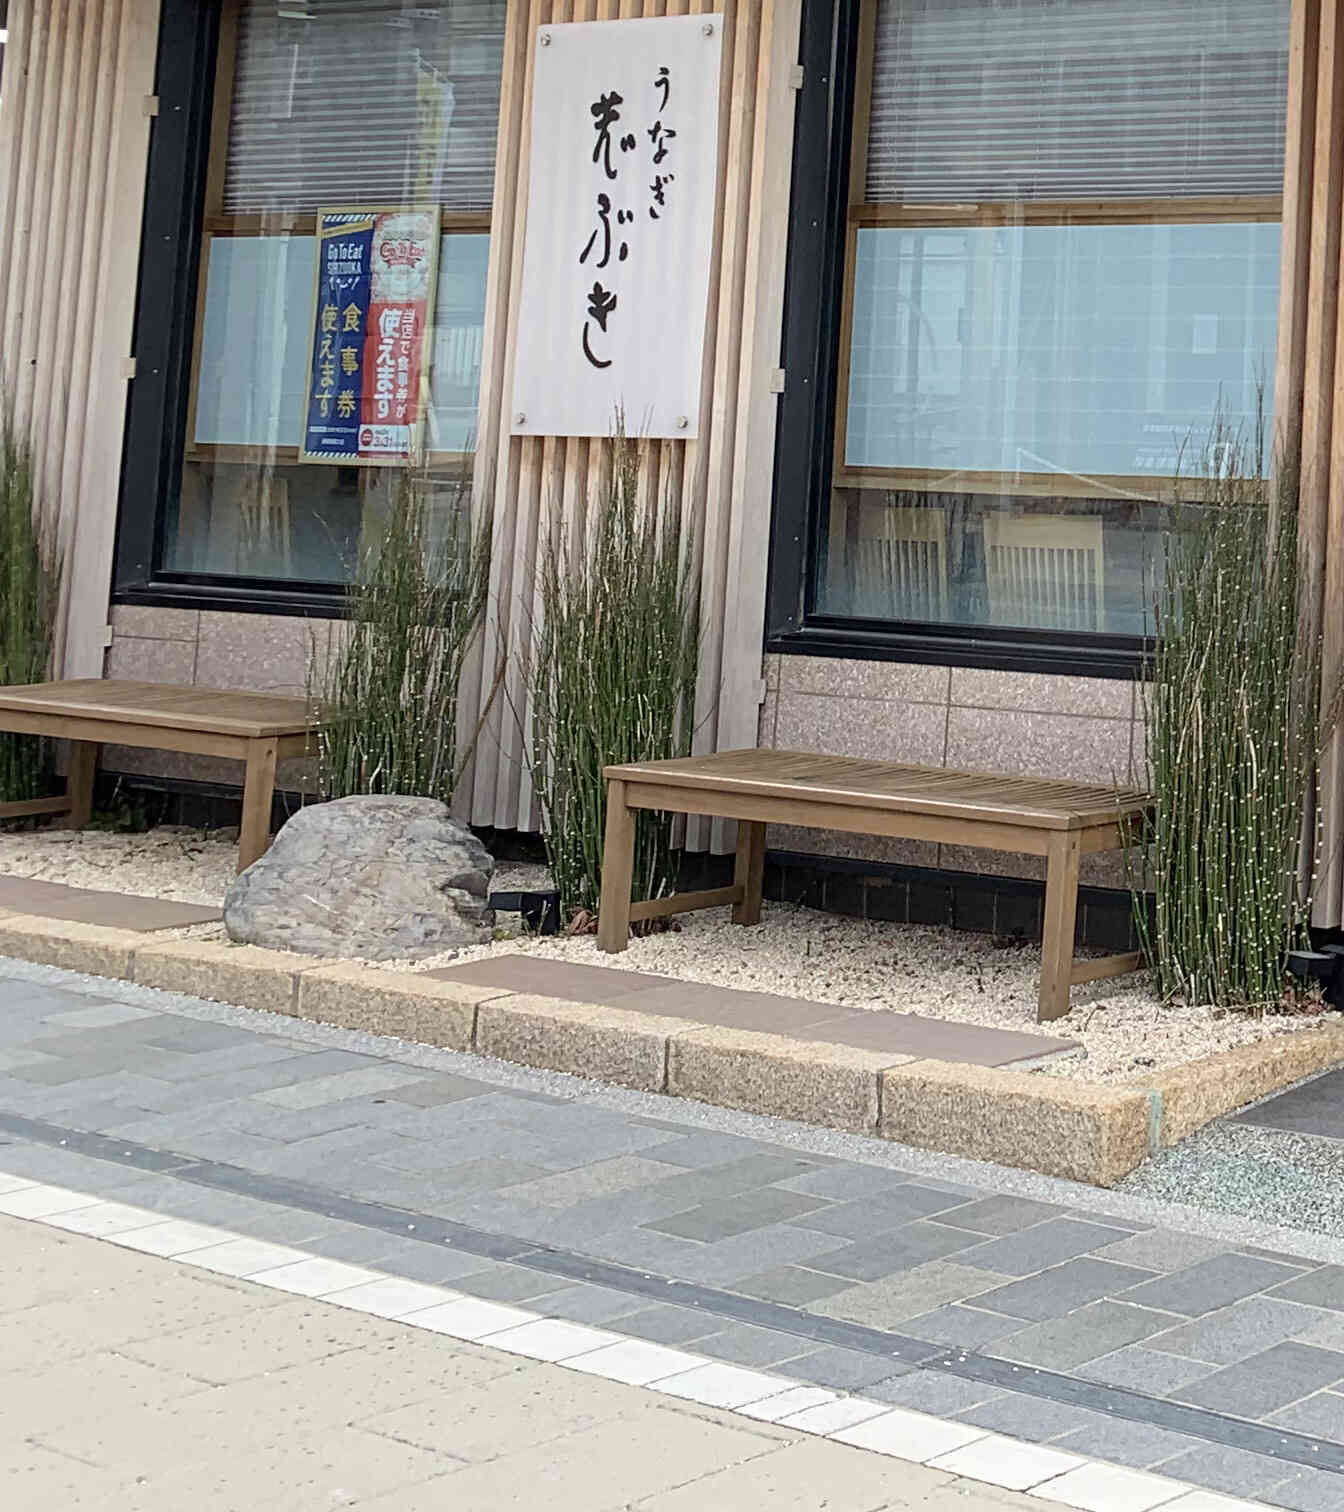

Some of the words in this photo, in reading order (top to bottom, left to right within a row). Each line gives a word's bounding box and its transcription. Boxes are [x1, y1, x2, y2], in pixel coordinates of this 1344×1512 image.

[646, 66, 677, 220] うなぎ
[314, 304, 339, 418] 使えます
[336, 303, 363, 418] 食事券
[374, 308, 402, 419] 使えます
